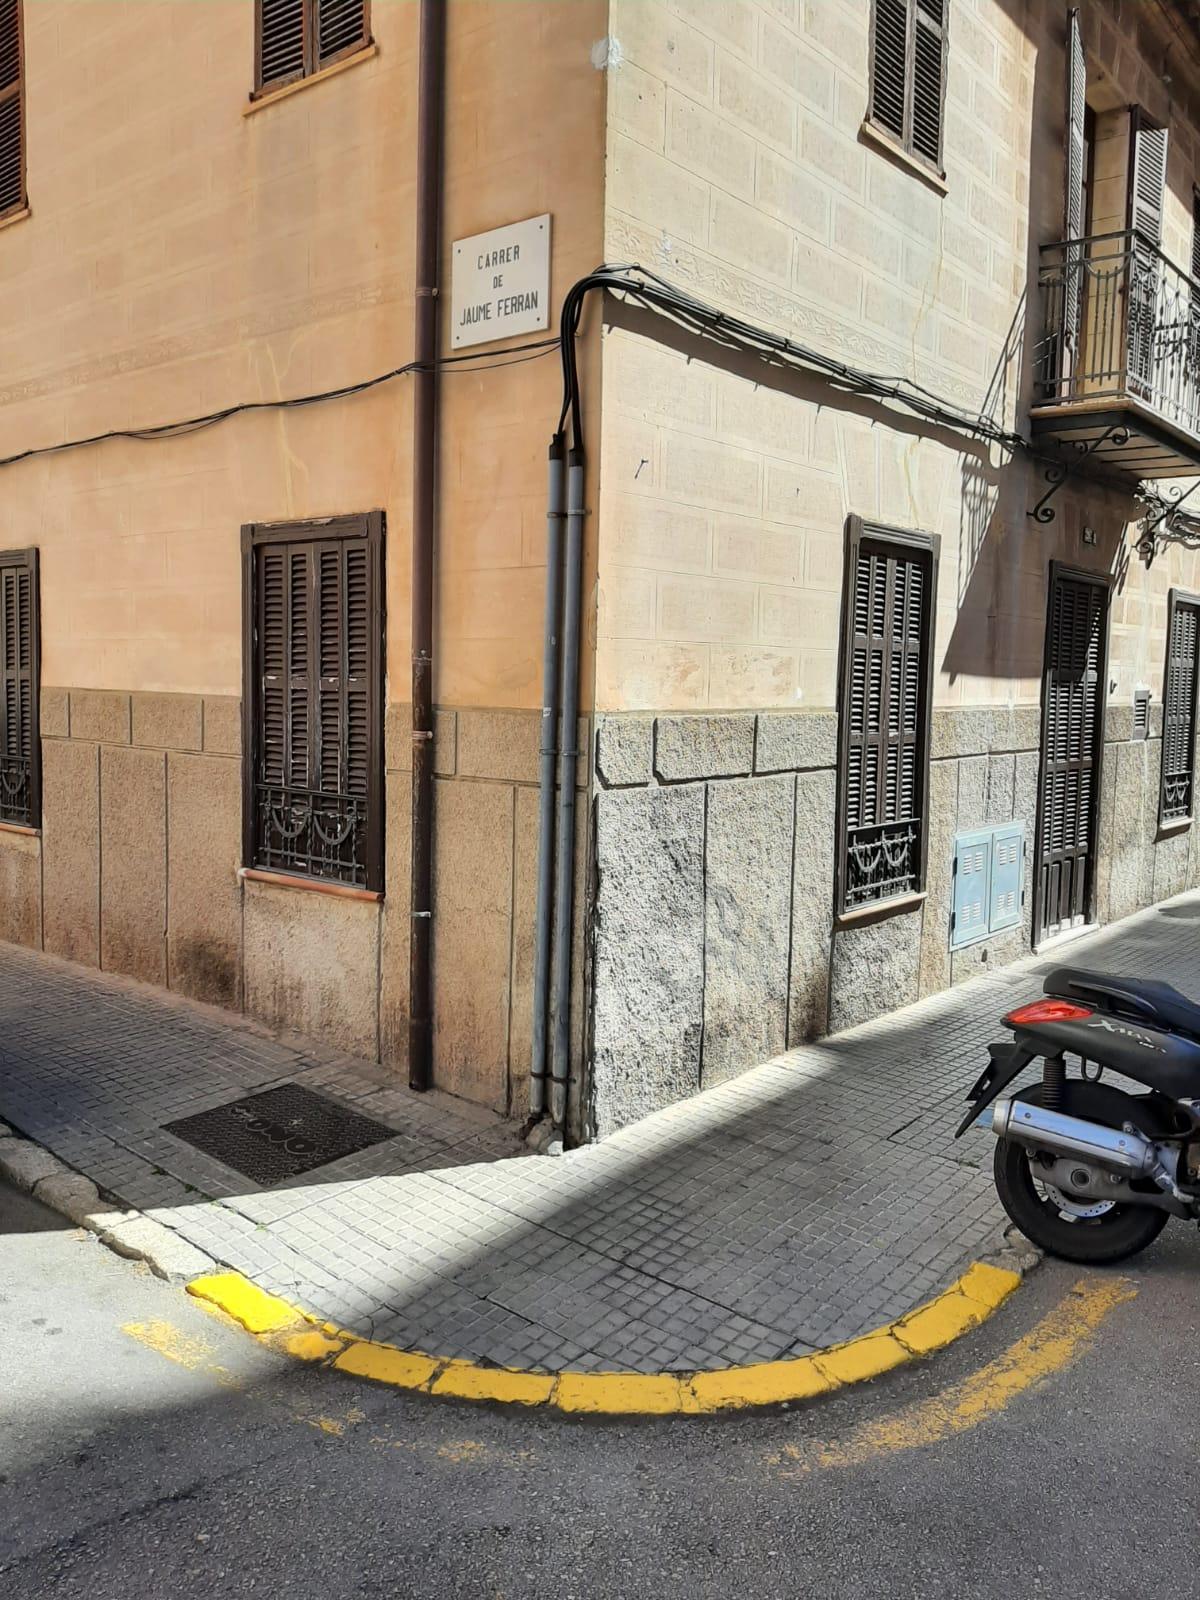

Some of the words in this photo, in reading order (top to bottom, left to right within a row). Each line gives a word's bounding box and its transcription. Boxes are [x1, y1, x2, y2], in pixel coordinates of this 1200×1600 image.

[477, 244, 520, 270] CARRER
[492, 274, 503, 289] DE
[459, 302, 492, 326] JAUME
[497, 290, 538, 318] FERRAN
